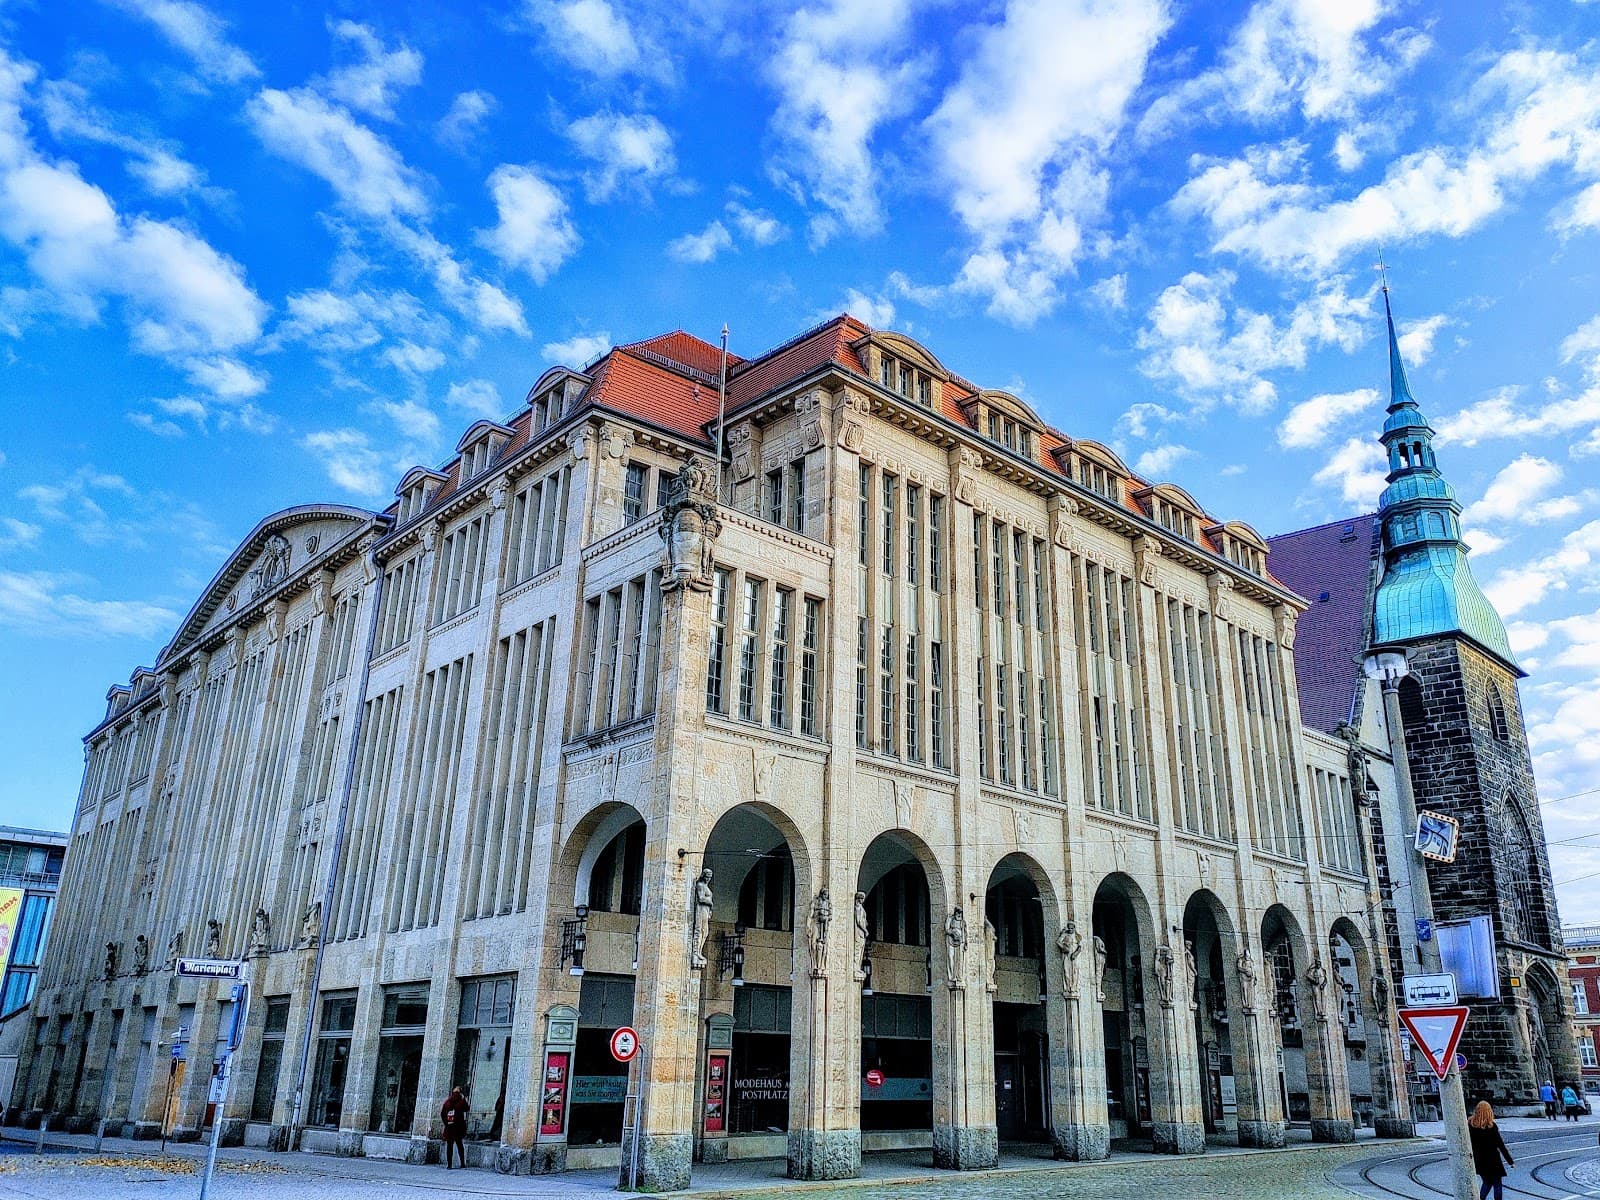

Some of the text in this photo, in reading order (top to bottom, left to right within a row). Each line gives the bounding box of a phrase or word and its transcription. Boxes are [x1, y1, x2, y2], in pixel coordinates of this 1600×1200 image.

[184, 962, 236, 977] Marienplatz
[575, 1080, 591, 1089] Hier
[734, 1079, 782, 1089] MODEHAUS
[741, 1090, 788, 1100] POSTPLATZ
